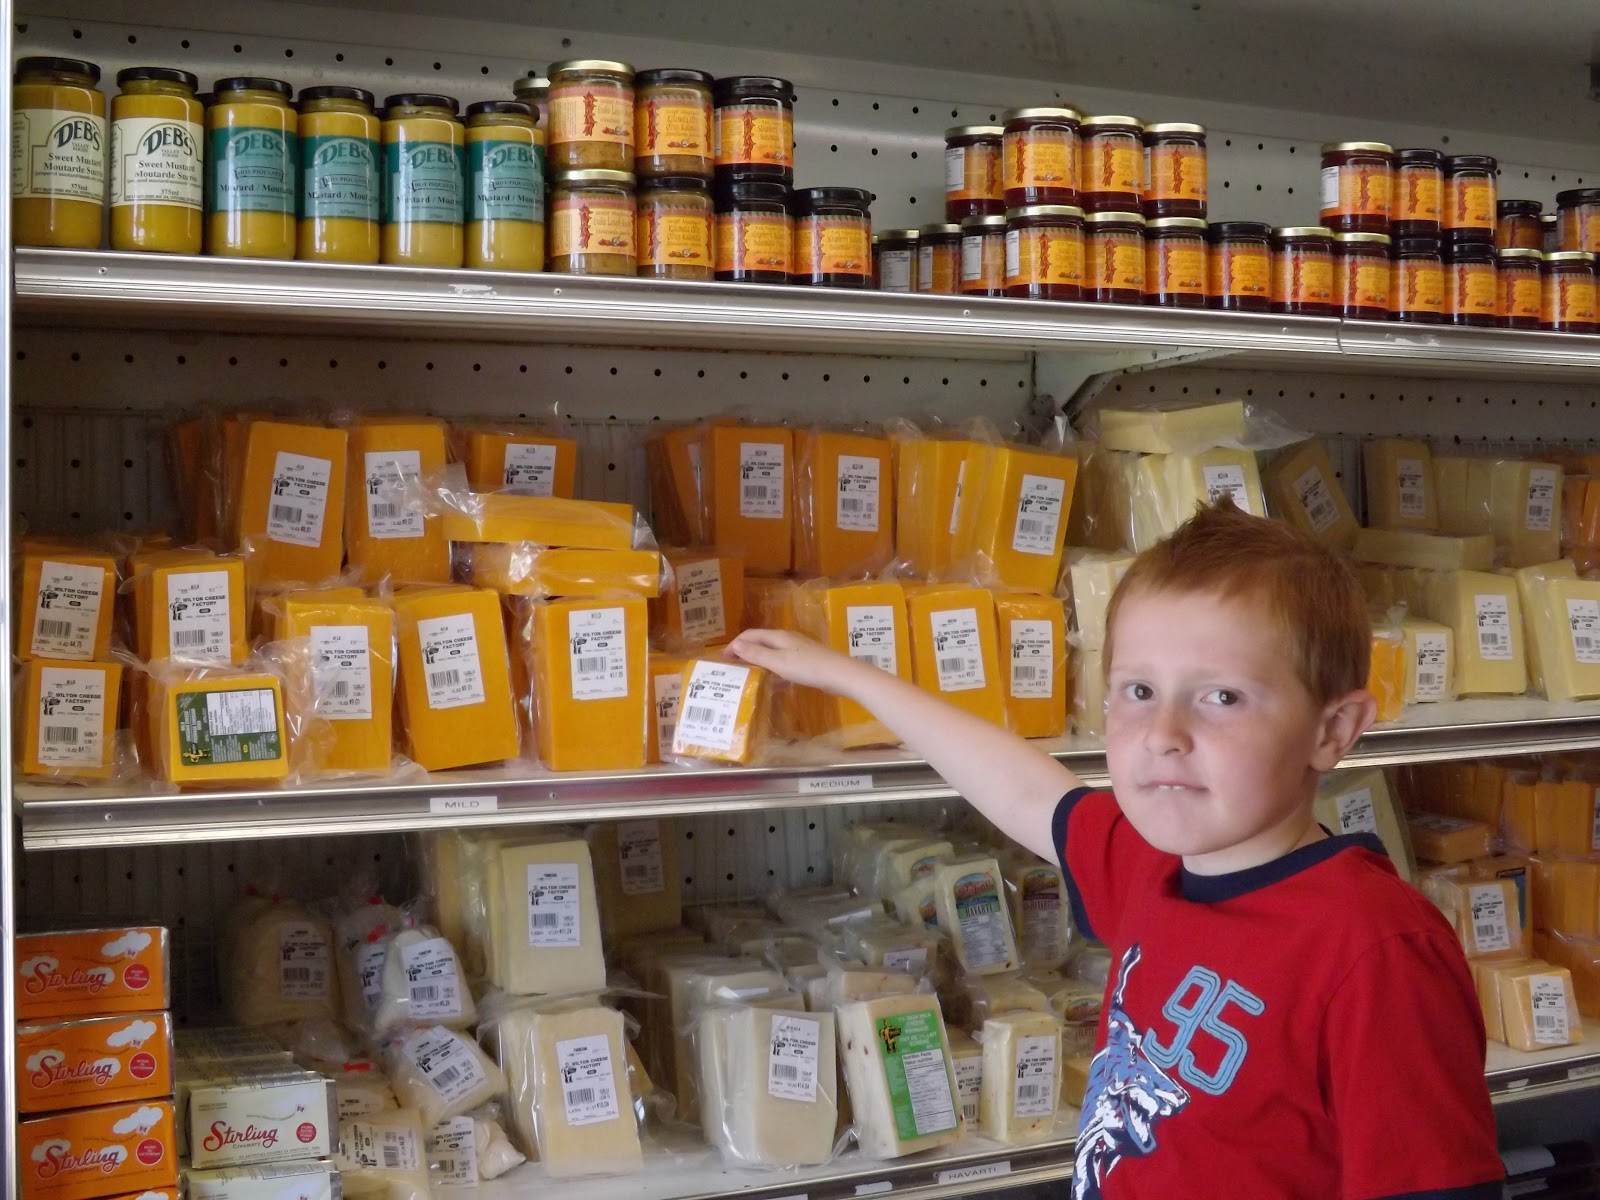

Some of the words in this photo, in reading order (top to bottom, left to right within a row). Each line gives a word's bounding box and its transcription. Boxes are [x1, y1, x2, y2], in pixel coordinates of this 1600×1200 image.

[53, 120, 100, 151] DEB'S
[142, 126, 193, 156] DEB'S
[48, 152, 74, 162] Sweet
[43, 162, 84, 173] Moutarde
[139, 160, 163, 168] Sweet
[135, 170, 175, 178] Moutarde
[286, 475, 306, 483] WILTON
[306, 479, 326, 487] CHEESE
[293, 482, 317, 490] FACTORY
[442, 642, 466, 650] FACTORY
[721, 682, 741, 690] CHEESE
[809, 779, 860, 789] MEDIUM
[444, 800, 480, 809] MILD
[416, 961, 435, 969] WILTON
[435, 957, 453, 965] CHEESE
[424, 962, 447, 971] FACTORY
[25, 961, 107, 994] Stirling
[1143, 964, 1266, 1095] 95
[31, 1055, 113, 1089] Stirling
[203, 1120, 279, 1152] Stirling
[453, 1130, 472, 1138] CHEESE
[38, 1144, 120, 1178] Stirling
[948, 1166, 997, 1180] HAVARTI
